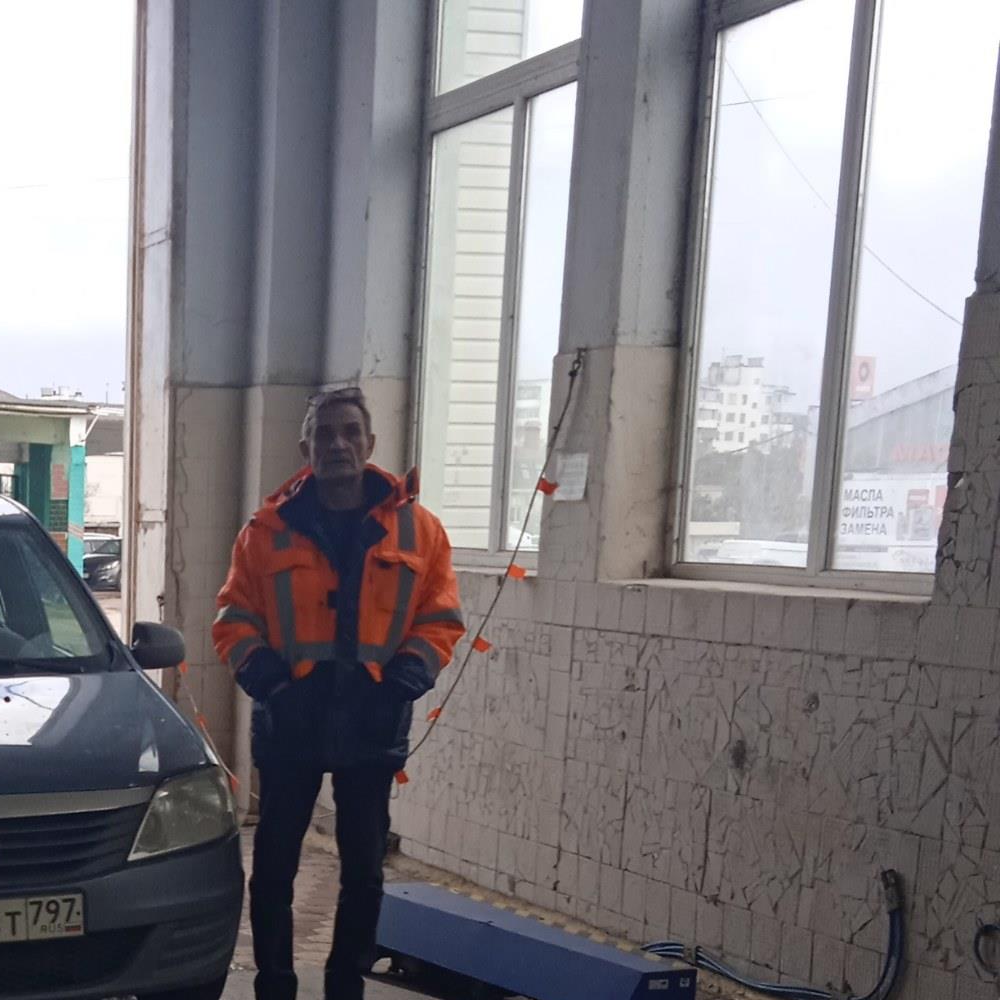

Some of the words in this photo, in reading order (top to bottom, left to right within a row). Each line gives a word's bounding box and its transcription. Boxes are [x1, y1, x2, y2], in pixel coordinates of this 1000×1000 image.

[844, 489, 883, 501] МАСЛА
[842, 506, 894, 519] ФИЛЬТРА
[840, 523, 888, 536] ЗАМЕНА
[29, 898, 76, 926] 797
[40, 924, 63, 933] RUS
